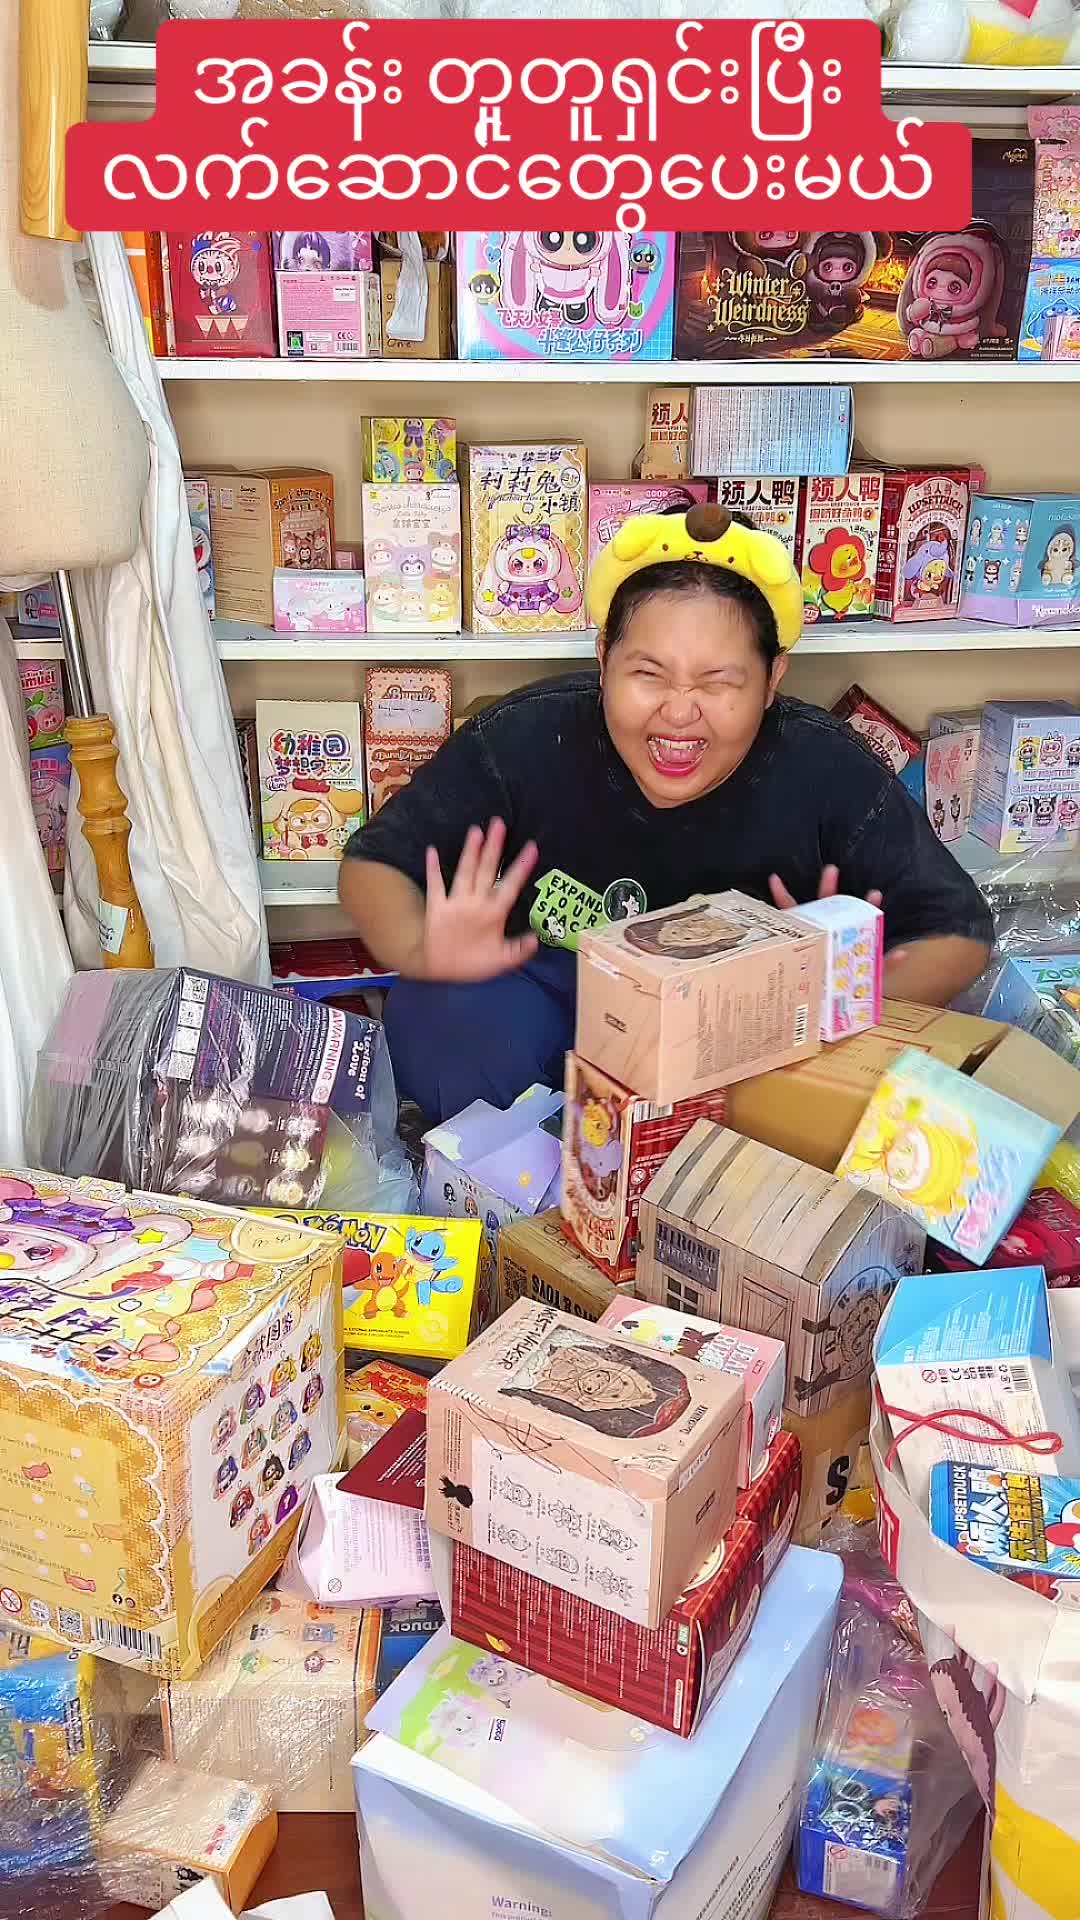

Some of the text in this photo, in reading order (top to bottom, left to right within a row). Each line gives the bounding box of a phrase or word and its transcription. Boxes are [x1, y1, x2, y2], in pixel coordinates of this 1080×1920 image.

[545, 887, 597, 927] YOUR
[550, 875, 603, 913] EXPAND
[537, 900, 588, 933] SPAC
[953, 1465, 968, 1532] UPSETDUCK
[491, 1895, 553, 1918] Warning:
